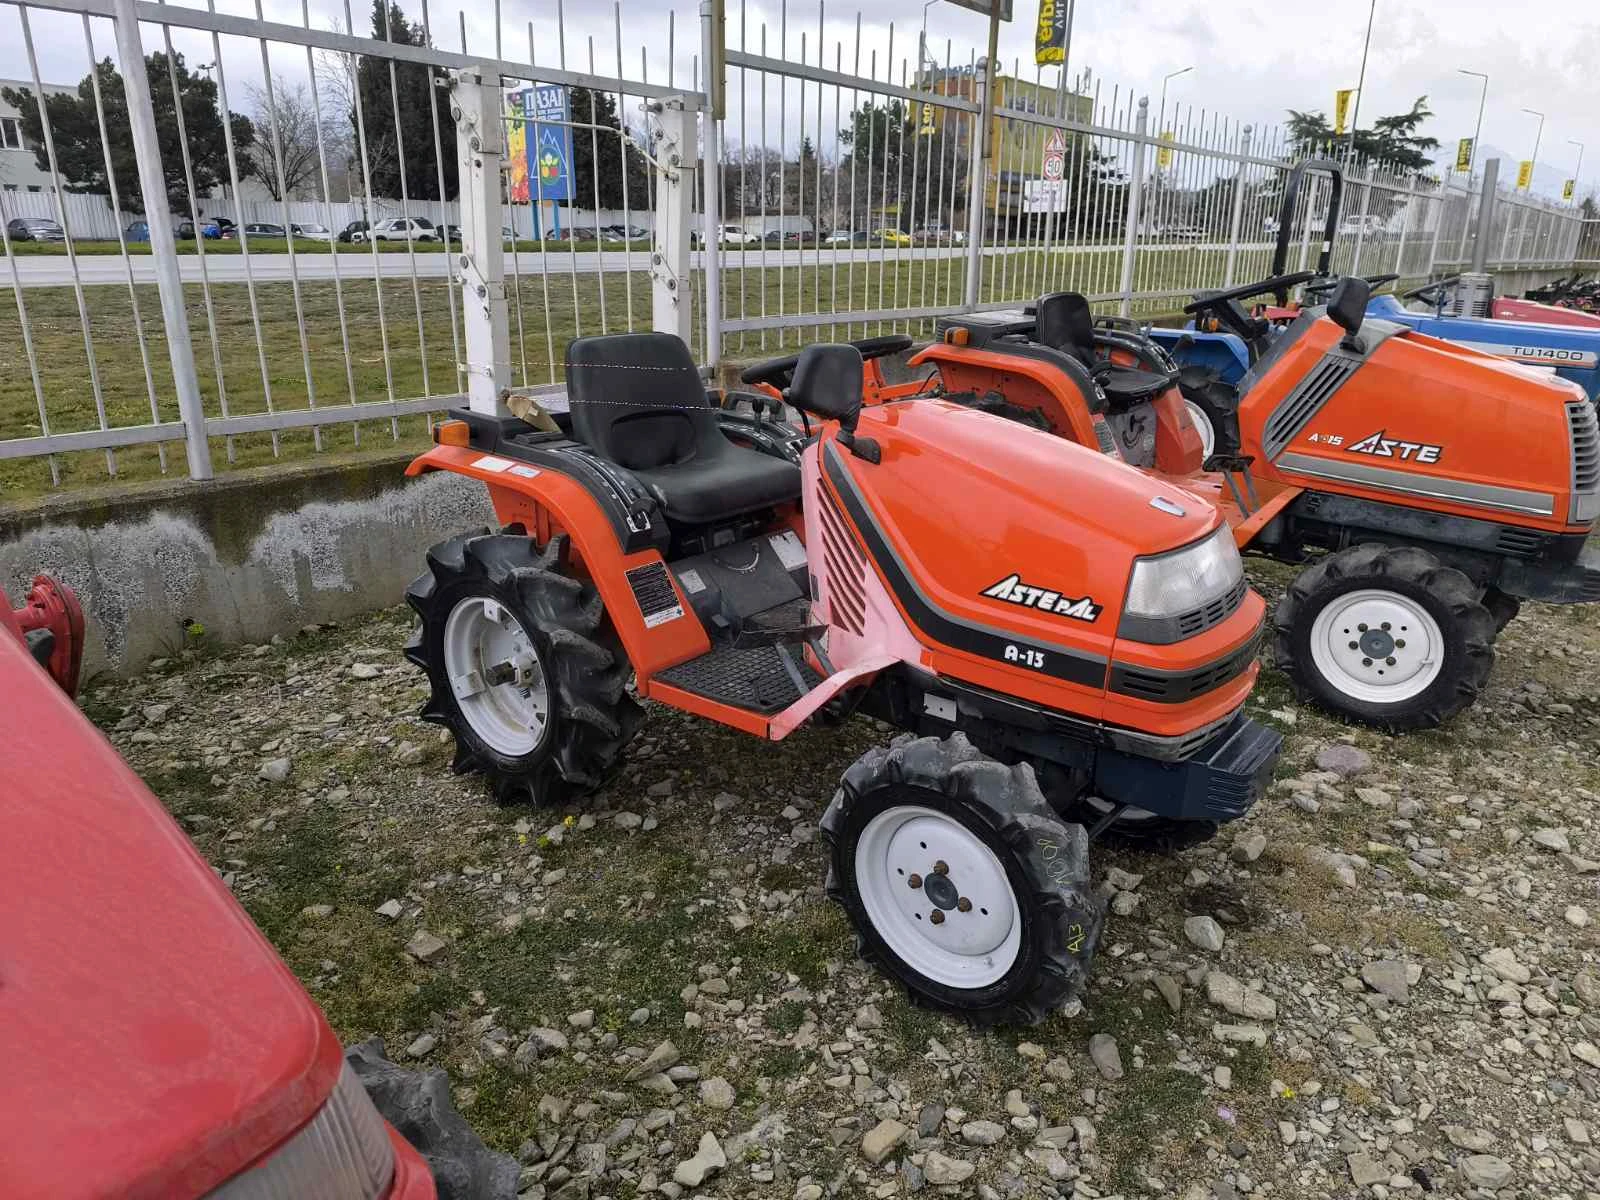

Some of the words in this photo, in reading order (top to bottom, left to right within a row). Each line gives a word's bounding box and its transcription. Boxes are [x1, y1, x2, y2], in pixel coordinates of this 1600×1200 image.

[1048, 160, 1060, 173] 50
[1512, 347, 1583, 360] TU1400
[1346, 430, 1442, 463] ASTE
[1004, 645, 1044, 668] A-13
